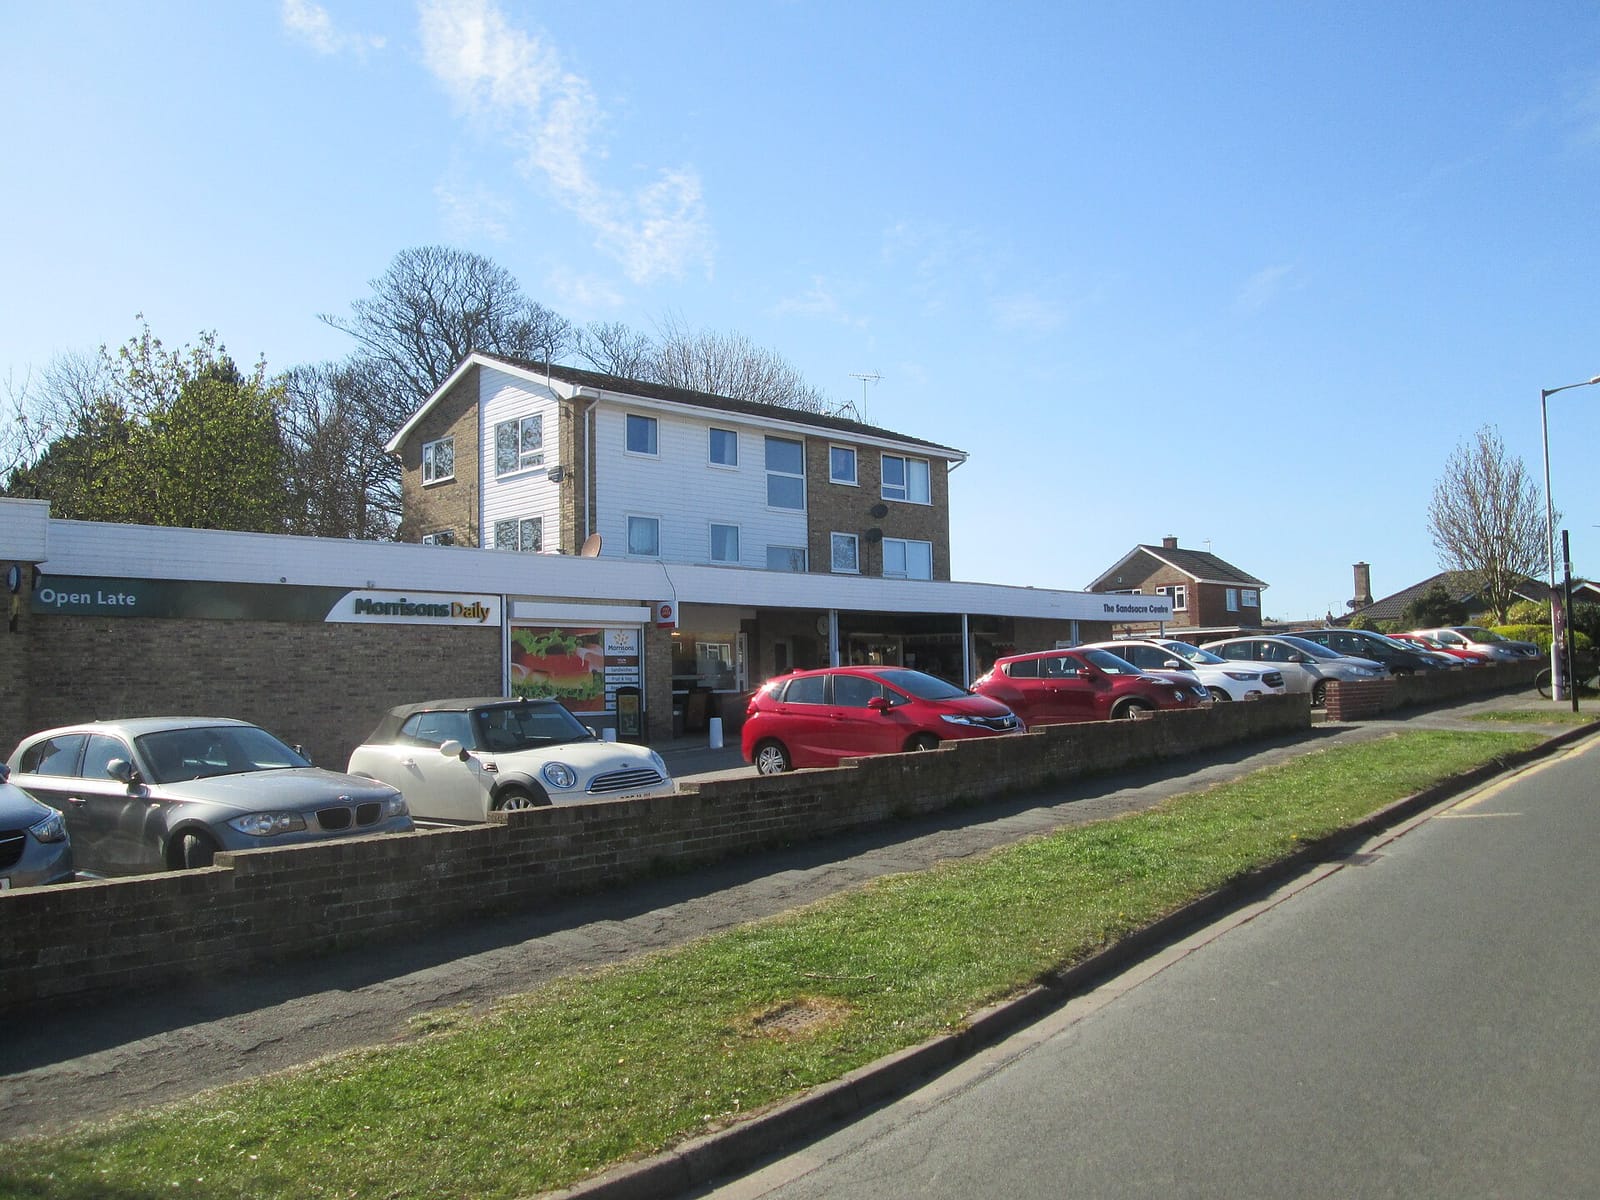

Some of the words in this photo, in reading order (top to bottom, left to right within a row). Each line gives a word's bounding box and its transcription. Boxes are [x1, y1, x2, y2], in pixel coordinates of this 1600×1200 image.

[40, 588, 91, 607] Open
[97, 590, 137, 606] Late
[354, 597, 450, 617] Morrisons
[451, 601, 491, 624] Daily
[1103, 603, 1115, 613] The
[1149, 604, 1169, 614] Centre
[607, 644, 635, 652] Morrisons
